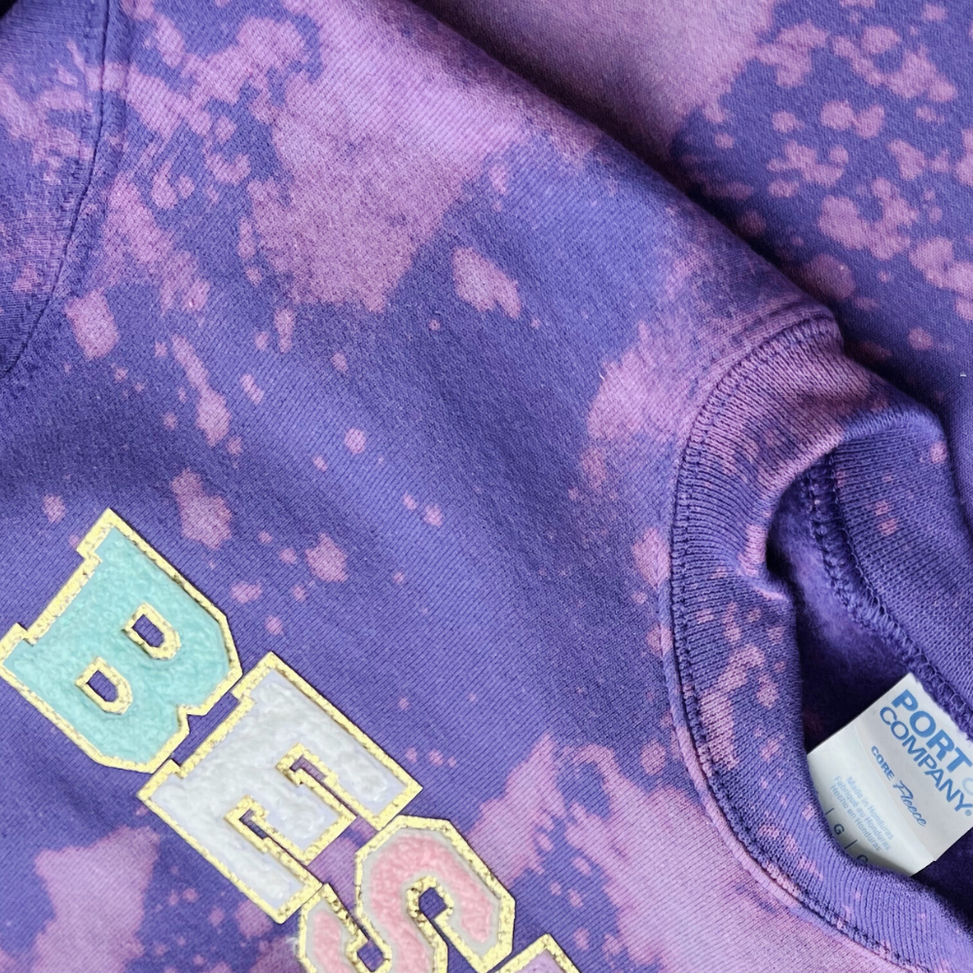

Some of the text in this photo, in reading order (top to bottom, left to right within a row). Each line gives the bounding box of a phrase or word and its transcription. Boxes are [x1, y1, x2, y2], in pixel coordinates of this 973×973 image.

[891, 689, 973, 773] PORT
[830, 784, 849, 810] Hecho
[847, 808, 857, 819] en
[854, 818, 881, 852] Honduras
[846, 776, 863, 799] Made
[867, 805, 894, 840] Honduras
[870, 745, 927, 828] CORE Fleece
[833, 823, 845, 836] G
[856, 807, 867, 818] au
[864, 815, 891, 851] Honduras
